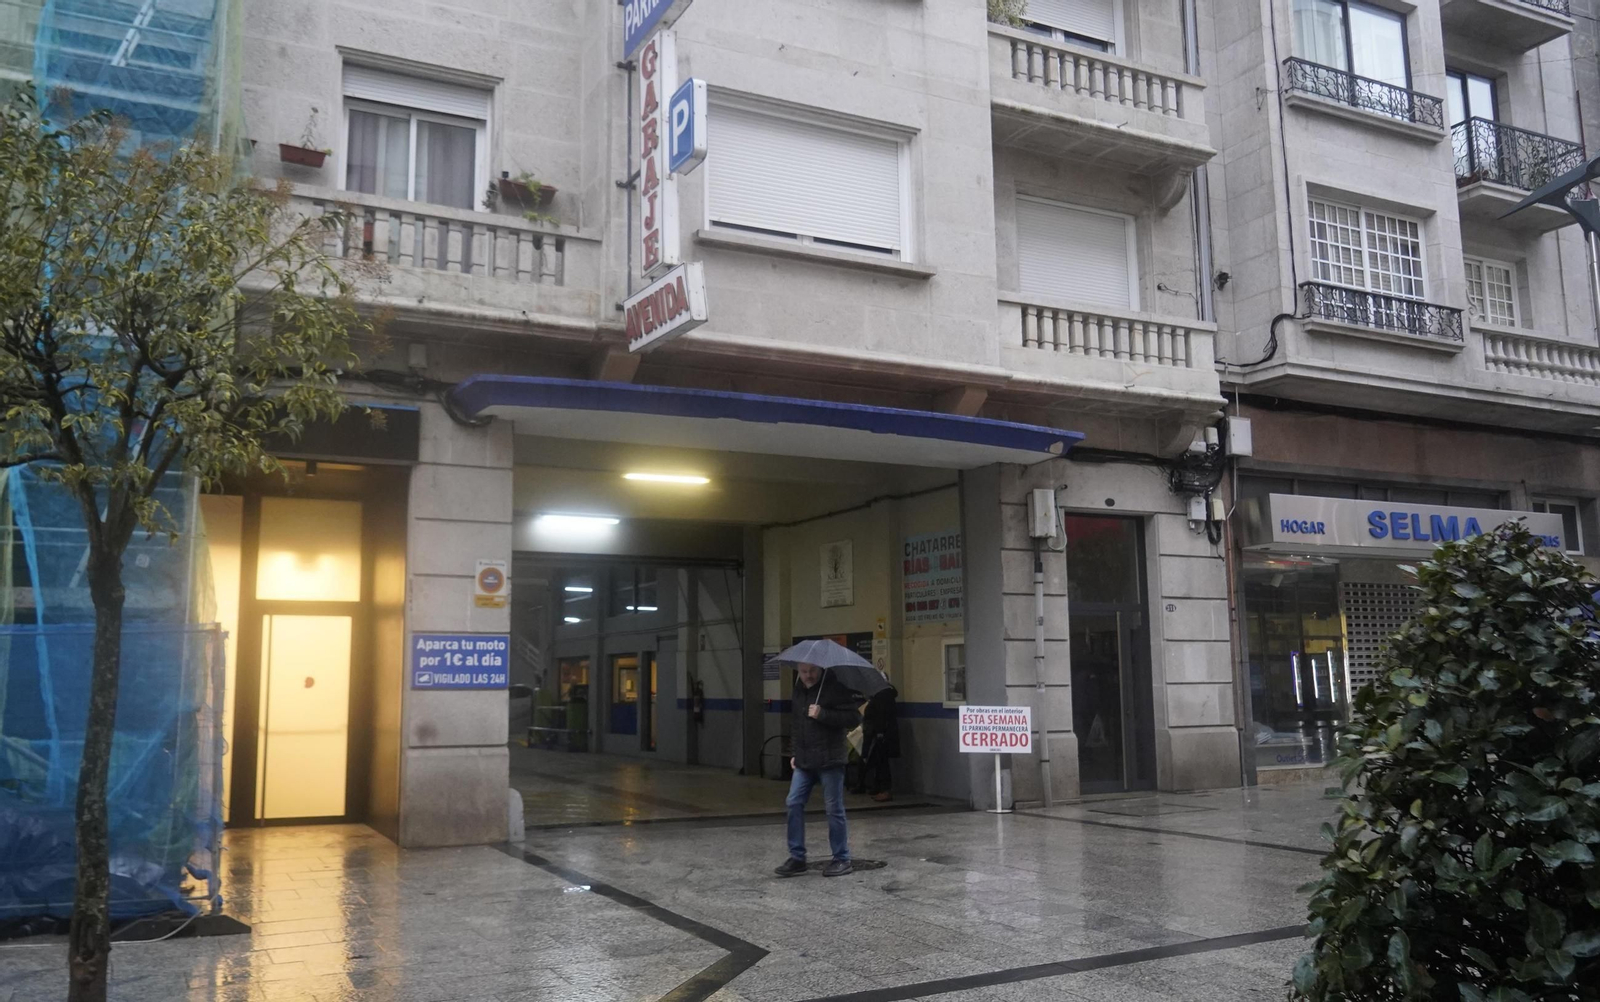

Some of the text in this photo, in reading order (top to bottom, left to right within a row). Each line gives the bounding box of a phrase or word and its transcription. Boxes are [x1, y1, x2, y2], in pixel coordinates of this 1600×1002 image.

[672, 98, 689, 156] P
[641, 39, 660, 272] GARAJE
[626, 275, 689, 345] AVENIDA
[1280, 518, 1326, 535] HOGAR
[1367, 510, 1484, 543] SELMA
[904, 533, 961, 557] CHATARRE
[417, 638, 506, 652] Aparca tu moto
[420, 652, 502, 668] por 1€ al día
[433, 673, 506, 684] VIGILADO LAS 24H
[962, 714, 1027, 725] ESTA SEMANA
[962, 732, 1029, 747] CERRADO
